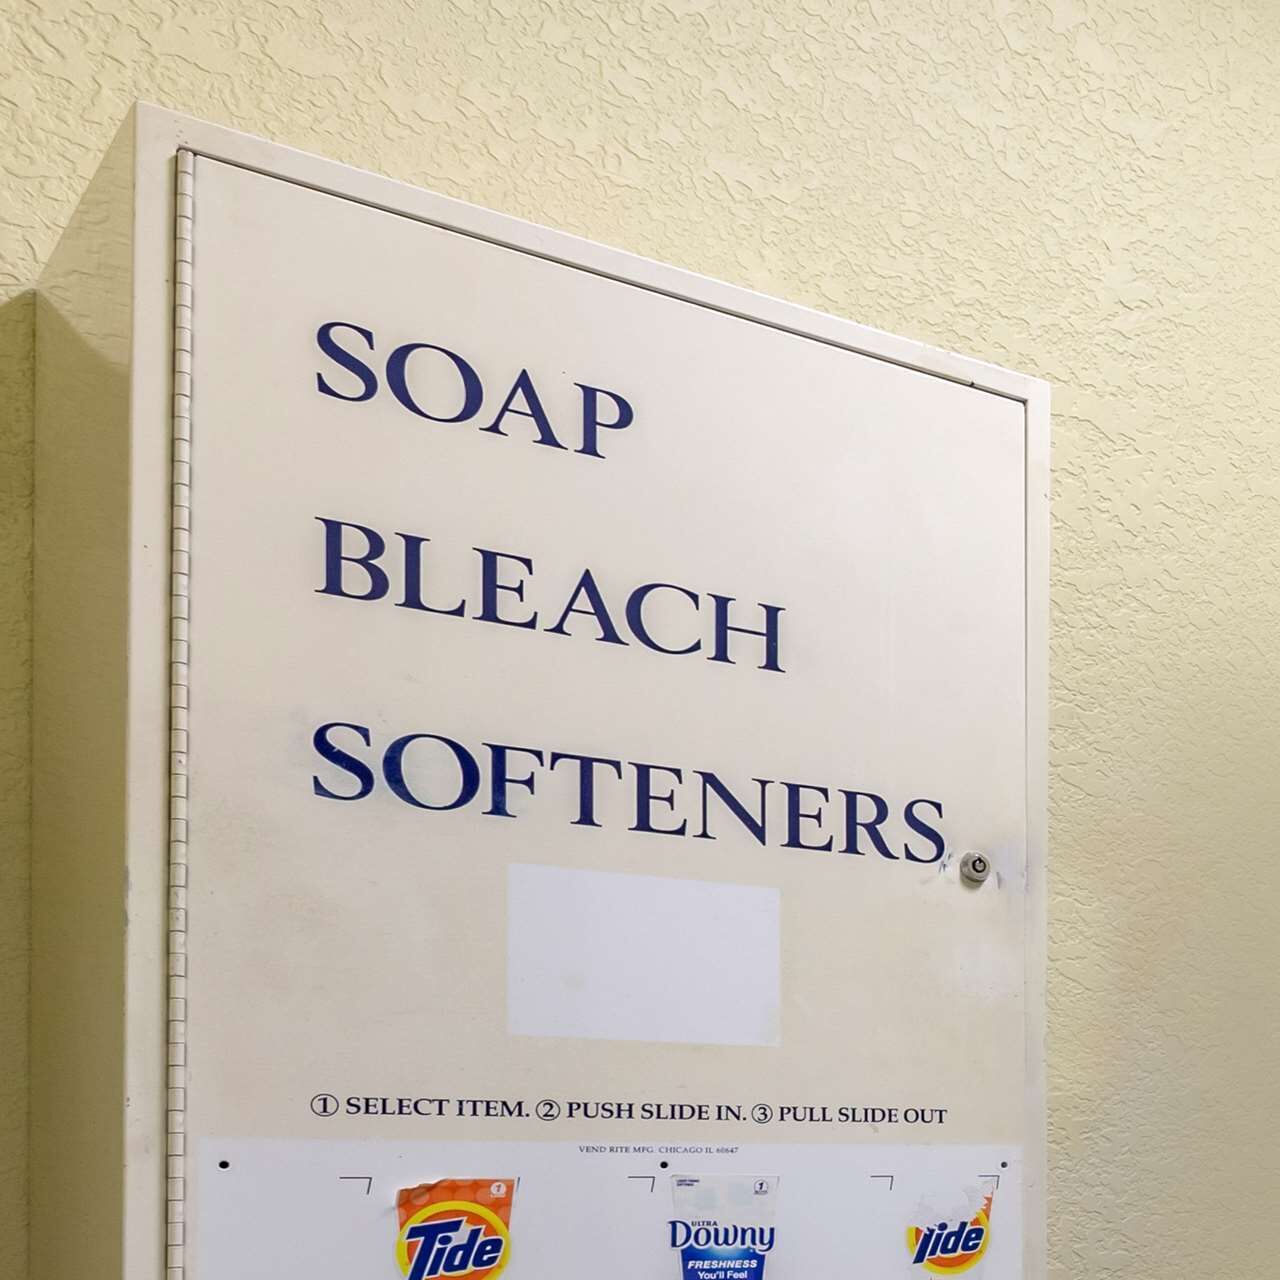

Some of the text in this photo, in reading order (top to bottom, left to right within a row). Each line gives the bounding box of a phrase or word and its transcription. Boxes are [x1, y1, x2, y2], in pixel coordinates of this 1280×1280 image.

[315, 321, 634, 459] SOAP
[314, 516, 787, 673] BLEACH
[312, 722, 946, 864] SOFTENERS
[346, 1096, 450, 1116] SELECT
[456, 1099, 530, 1118] ITEM.
[566, 1102, 634, 1120] PUSH
[640, 1103, 711, 1121] SLIDE
[716, 1105, 747, 1121] IN.
[778, 1106, 833, 1123] PULL
[838, 1107, 899, 1123] SLIDE
[903, 1108, 948, 1124] OUT
[578, 1145, 607, 1154] VEND
[609, 1146, 631, 1154] RITE
[658, 1146, 703, 1155] CHICAGO
[667, 1219, 776, 1253] Downy
[687, 1259, 758, 1269] FRESHNESS
[698, 1270, 748, 1280] You'll Feel
